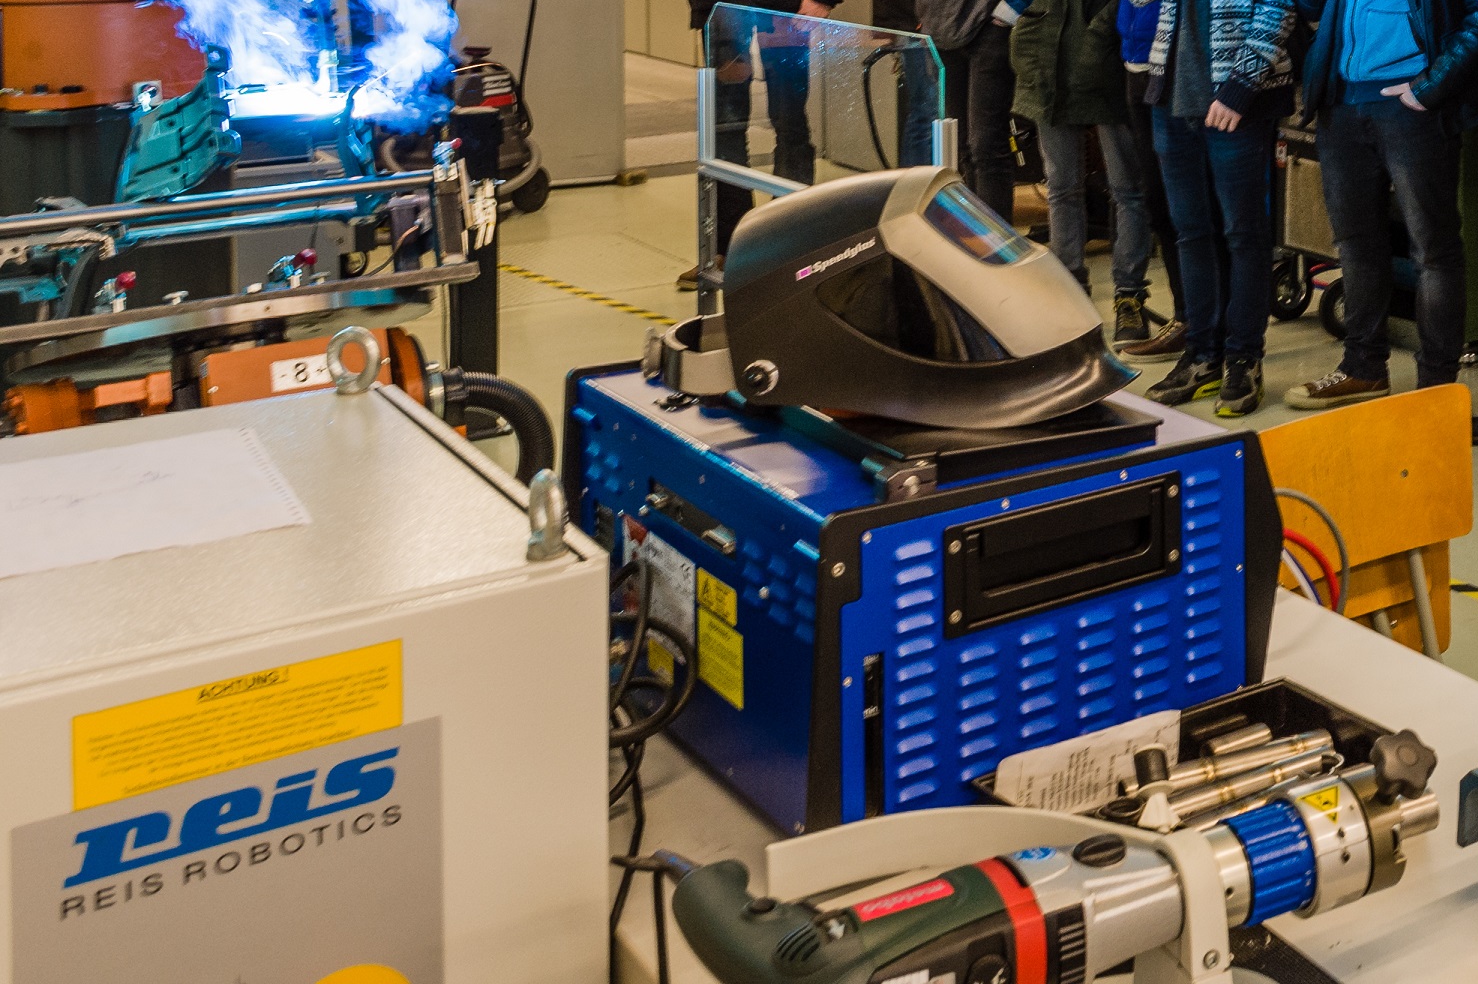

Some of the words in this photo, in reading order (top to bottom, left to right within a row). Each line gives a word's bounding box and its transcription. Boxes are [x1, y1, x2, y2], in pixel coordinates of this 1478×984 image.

[811, 237, 877, 274] Speedglas
[59, 872, 165, 921] REIS
[181, 804, 403, 886] ROBOTICS
[63, 746, 401, 889] reis
